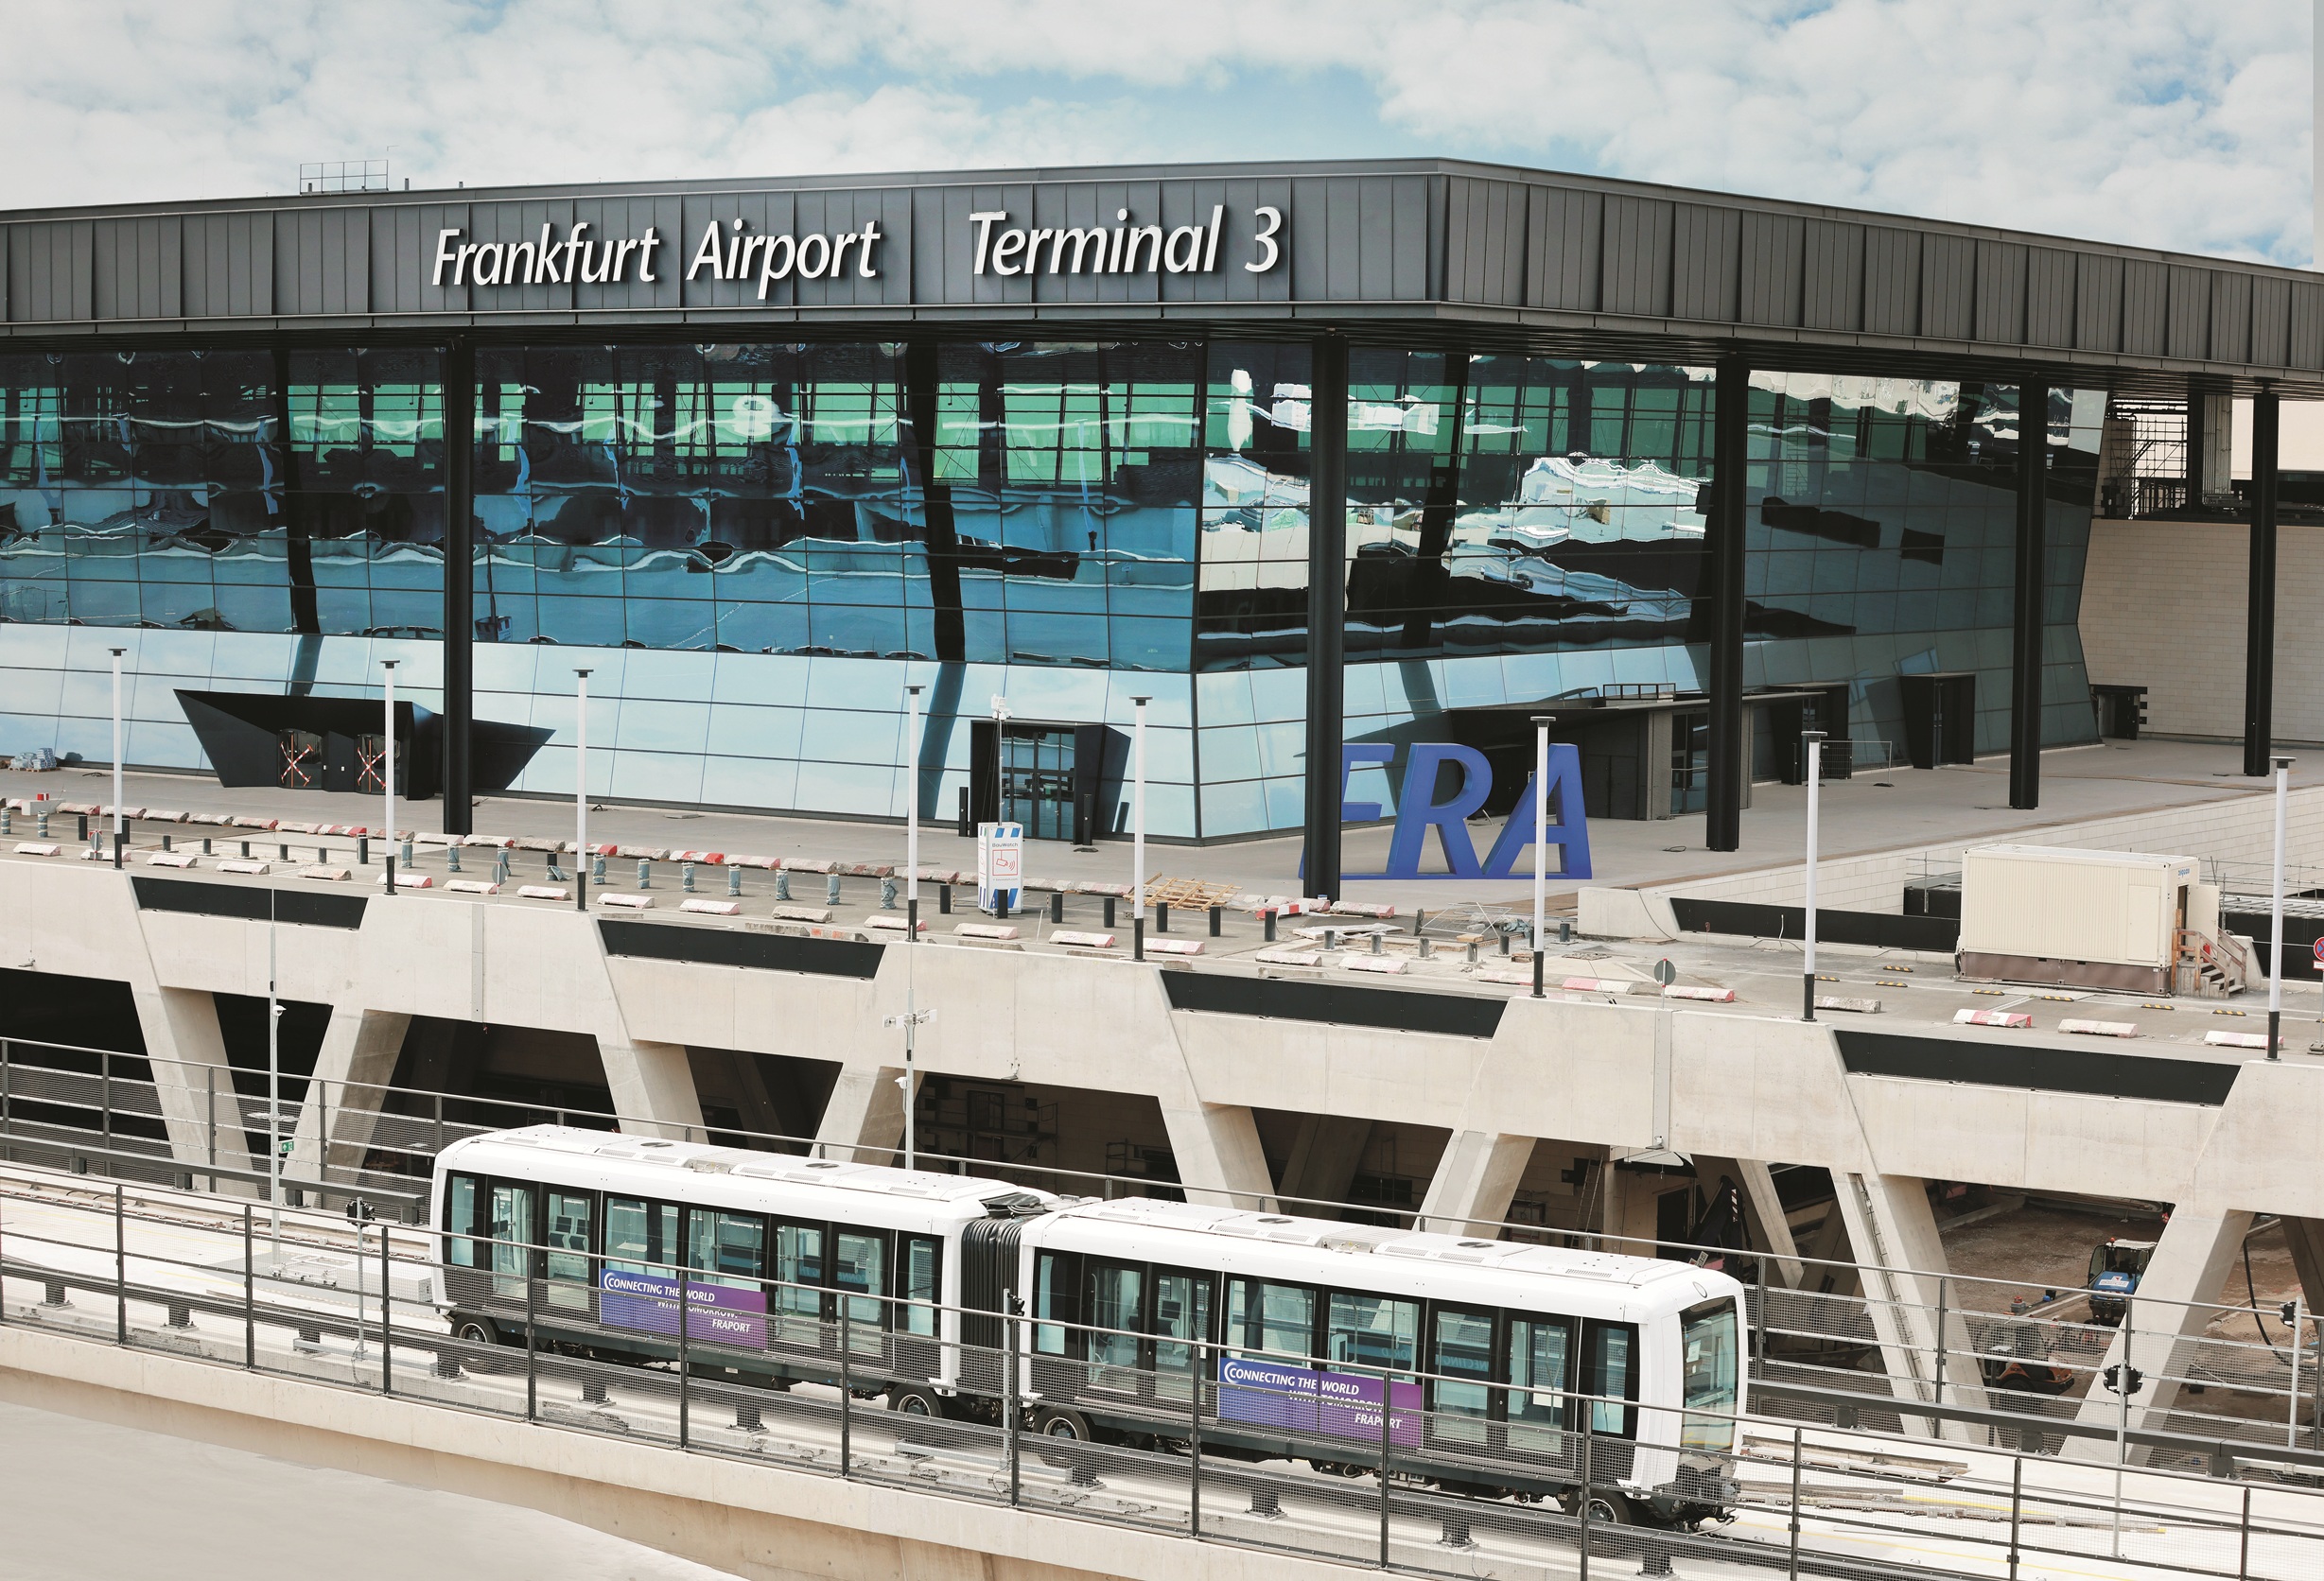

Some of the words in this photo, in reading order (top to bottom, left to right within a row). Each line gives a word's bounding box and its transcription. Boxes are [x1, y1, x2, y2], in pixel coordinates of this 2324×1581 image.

[431, 222, 660, 286] Frankfurt
[686, 218, 882, 300] Airport
[969, 204, 1227, 276] Terminal
[1245, 206, 1283, 273] 3
[608, 1277, 663, 1294] CONNECTING
[664, 1286, 680, 1297] THE
[686, 1289, 715, 1302] WORLD
[712, 1318, 751, 1333] FRAPORT
[1229, 1367, 1296, 1387] CONNECTING
[1297, 1377, 1318, 1390] THE
[1321, 1381, 1360, 1396] WORLD
